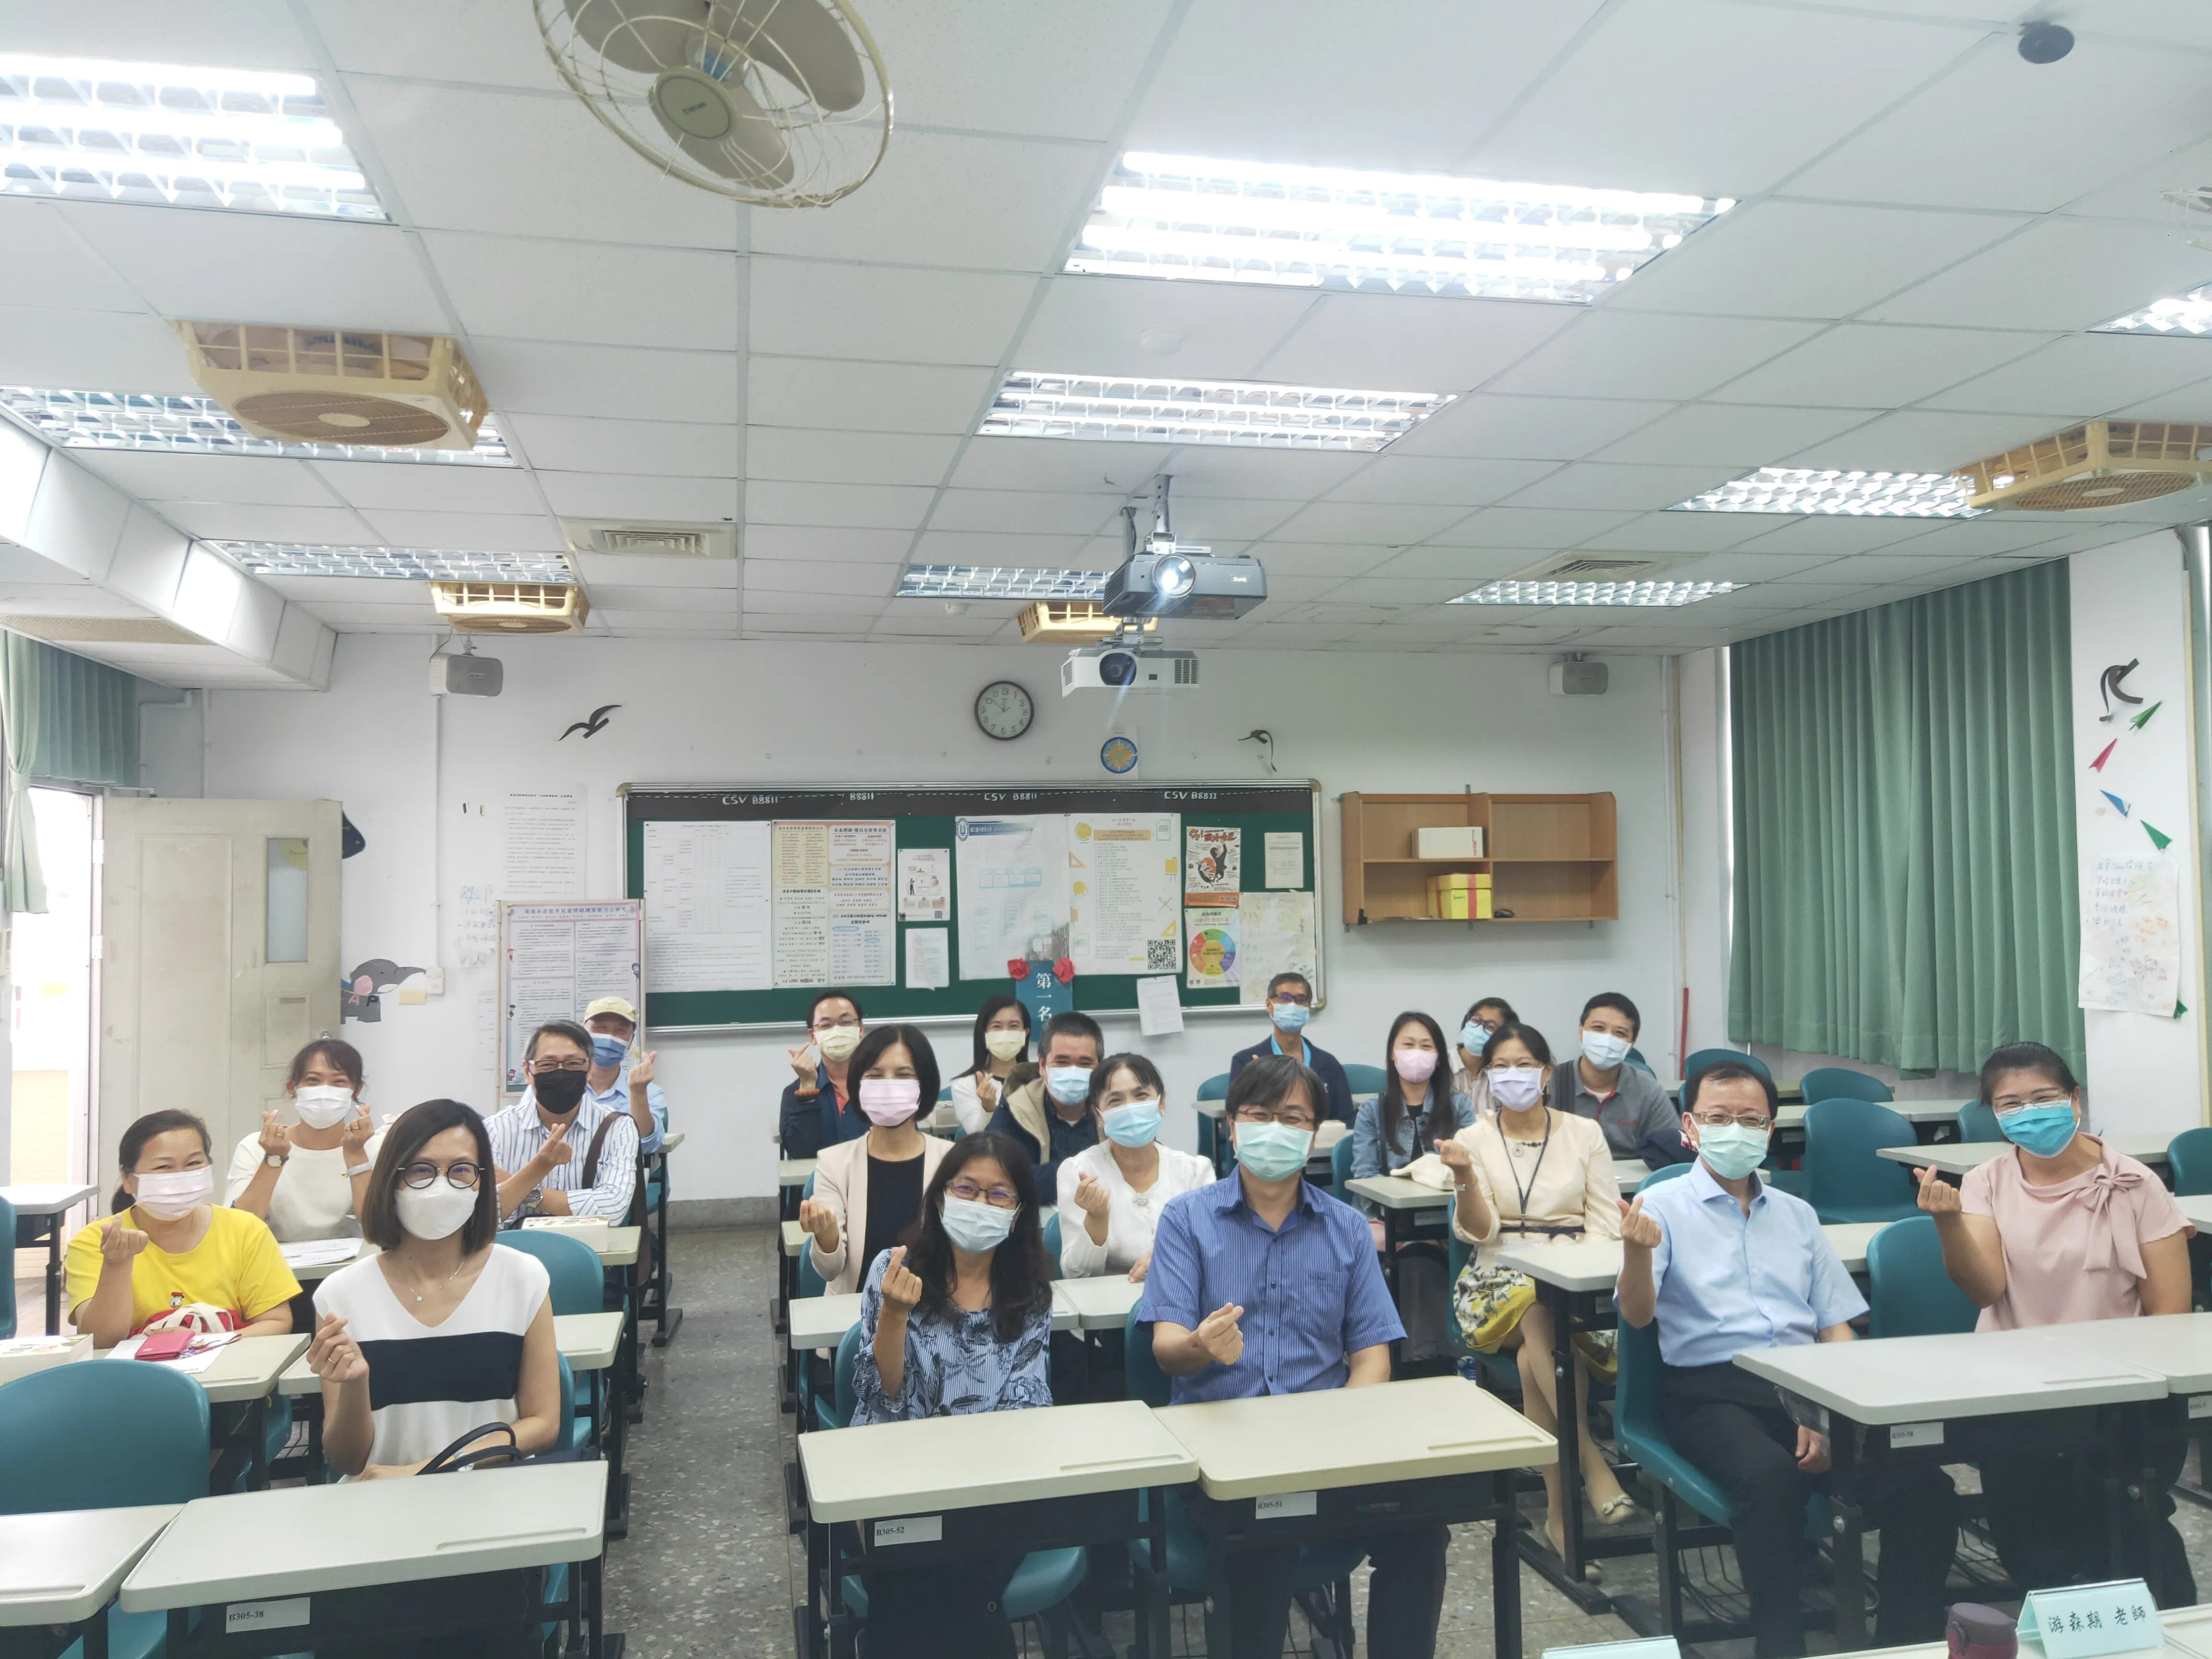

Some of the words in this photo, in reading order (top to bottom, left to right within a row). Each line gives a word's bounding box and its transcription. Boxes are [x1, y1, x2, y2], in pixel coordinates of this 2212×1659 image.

[1001, 727, 1006, 735] 6
[850, 793, 875, 801] B8811
[1013, 792, 1037, 800] B8811
[1164, 791, 1188, 799] CSV
[722, 796, 747, 805] CSV
[752, 796, 778, 804] B8811
[1036, 973, 1052, 1022] 第一名
[877, 1527, 905, 1536] B305-52
[2114, 1605, 2146, 1625] 老師
